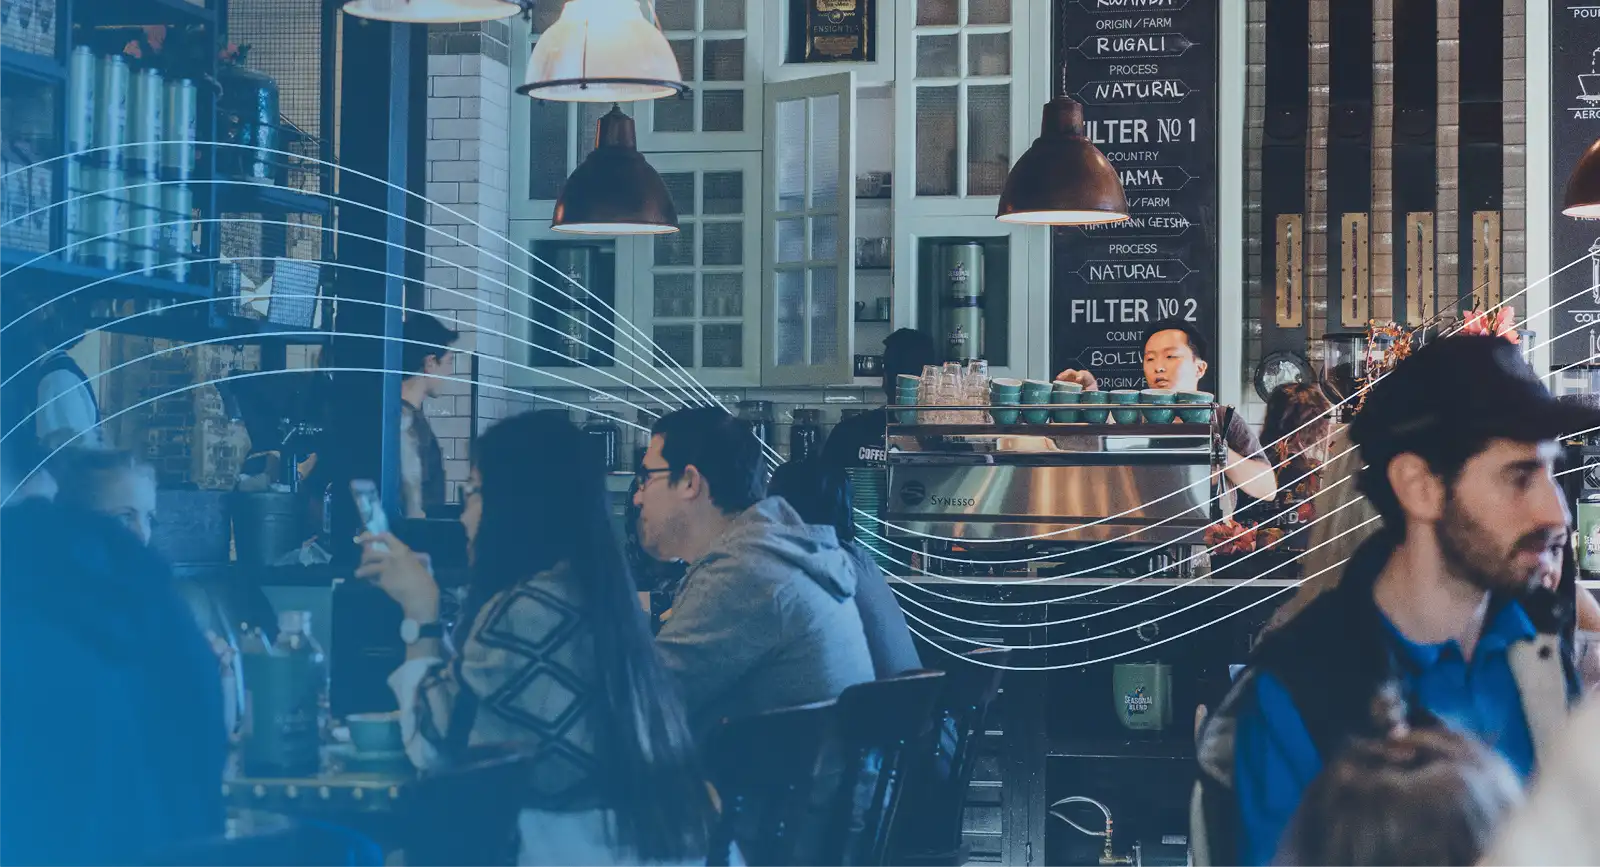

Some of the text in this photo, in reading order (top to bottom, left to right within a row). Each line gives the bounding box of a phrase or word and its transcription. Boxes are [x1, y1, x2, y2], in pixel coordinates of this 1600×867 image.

[1573, 9, 1600, 18] POU
[1097, 36, 1165, 54] RUGALI
[1109, 64, 1158, 75] PROCESS
[1095, 81, 1185, 99] NATURAL
[1083, 119, 1149, 144] ILTER
[1188, 118, 1196, 142] 1
[1107, 151, 1160, 162] COUNTRY
[1119, 169, 1164, 186] NAMA
[1148, 216, 1190, 229] GEISHA
[1109, 243, 1158, 254] PROCESS
[1089, 264, 1167, 281] NATURAL
[1071, 298, 1149, 323] FILTER
[1183, 298, 1197, 322] 2
[1106, 330, 1144, 342] COUNT
[1091, 350, 1143, 366] BOLIV
[1097, 377, 1146, 388] ORIGIN/F
[931, 494, 976, 507] SYNESSO
